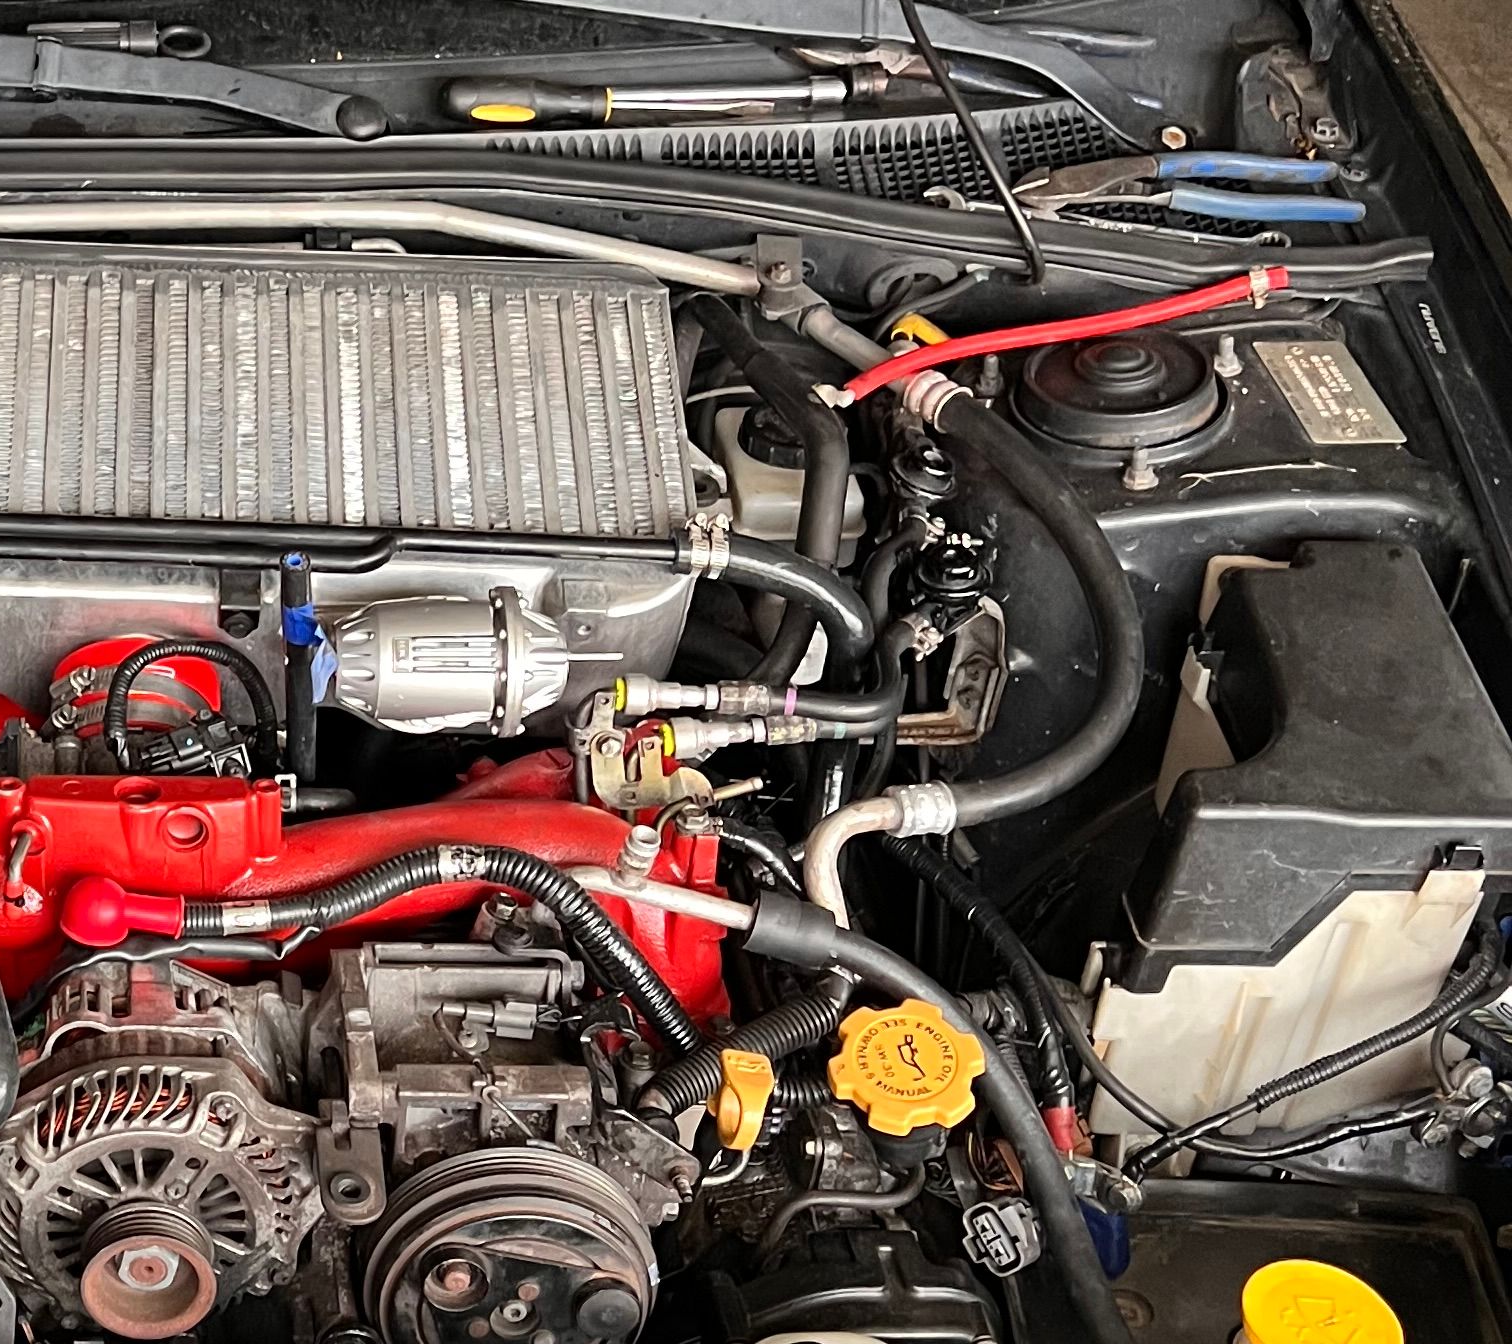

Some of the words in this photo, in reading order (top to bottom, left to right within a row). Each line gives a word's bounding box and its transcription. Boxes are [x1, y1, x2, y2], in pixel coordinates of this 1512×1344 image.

[916, 1022, 953, 1060] ENGINE
[934, 1065, 952, 1082] OIL
[876, 1080, 932, 1096] MANUAL
